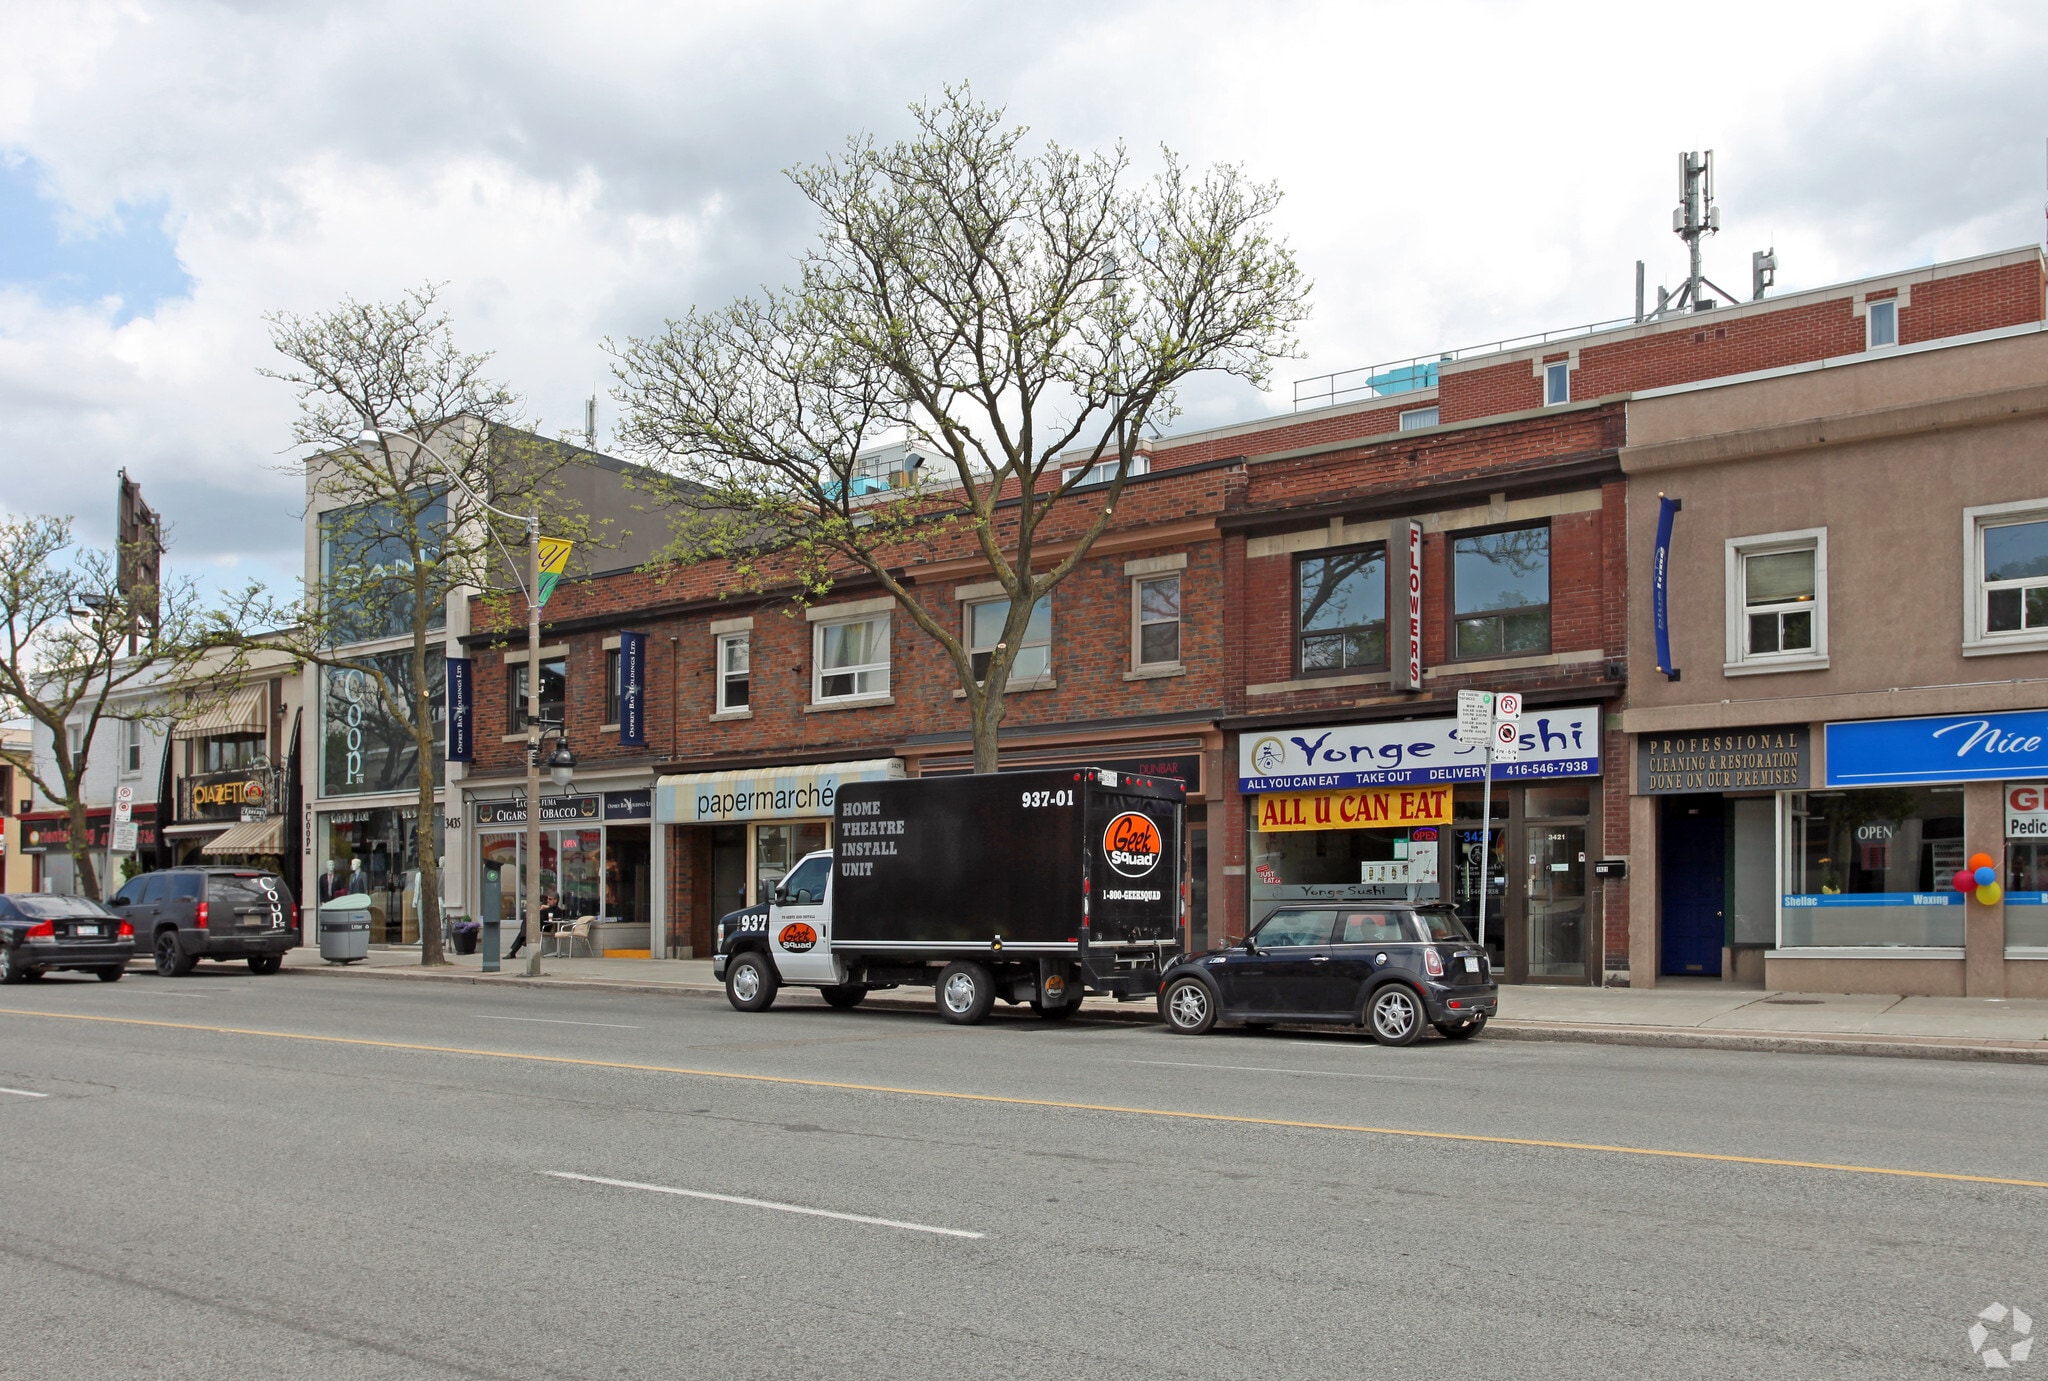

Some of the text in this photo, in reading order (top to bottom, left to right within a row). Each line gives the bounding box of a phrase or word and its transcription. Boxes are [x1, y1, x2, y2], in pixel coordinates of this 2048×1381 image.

[1410, 529, 1418, 681] FLOWERS
[1650, 733, 1798, 755] PROFESSIONAL
[1933, 721, 2042, 757] Nice
[1291, 732, 1435, 769] Yonge
[1139, 762, 1178, 775] DUNBAR
[1506, 761, 1588, 775] 416-546-7938
[1650, 752, 1798, 772] CLEANING & RESTORATION
[1356, 771, 1412, 784] TAKE OUT
[1429, 766, 1487, 780] DELIVERY
[1650, 769, 1798, 790] DONE ON OUR PREMISES
[1248, 775, 1340, 789] ALL YOU CAN EAT
[698, 780, 834, 820] papermarché
[1022, 790, 1073, 807] 937-01
[2009, 788, 2048, 811] G
[497, 807, 577, 822] CIGARS TOBACCO
[842, 801, 880, 817] HOME
[1262, 799, 1306, 826] ALL
[1340, 793, 1390, 823] CAN
[1400, 789, 1447, 820] EAT
[445, 818, 460, 830] 3435
[842, 820, 905, 837] THEATRE
[1114, 817, 1151, 852] Geek
[1412, 831, 1438, 841] OPEN
[1858, 825, 1893, 840] OPEN
[842, 841, 897, 857] INSTALL
[1111, 851, 1153, 866] Squad
[842, 862, 873, 877] UNIT
[1259, 871, 1275, 879] JUST
[1103, 889, 1161, 902] 1-800-GEEKSQUAD
[1301, 886, 1386, 899] Yonge Sushi
[1784, 896, 1818, 908] Shellac
[1912, 895, 1949, 907] Waxing
[741, 914, 768, 932] 937
[783, 924, 810, 941] Geek
[782, 942, 812, 950] Squad
